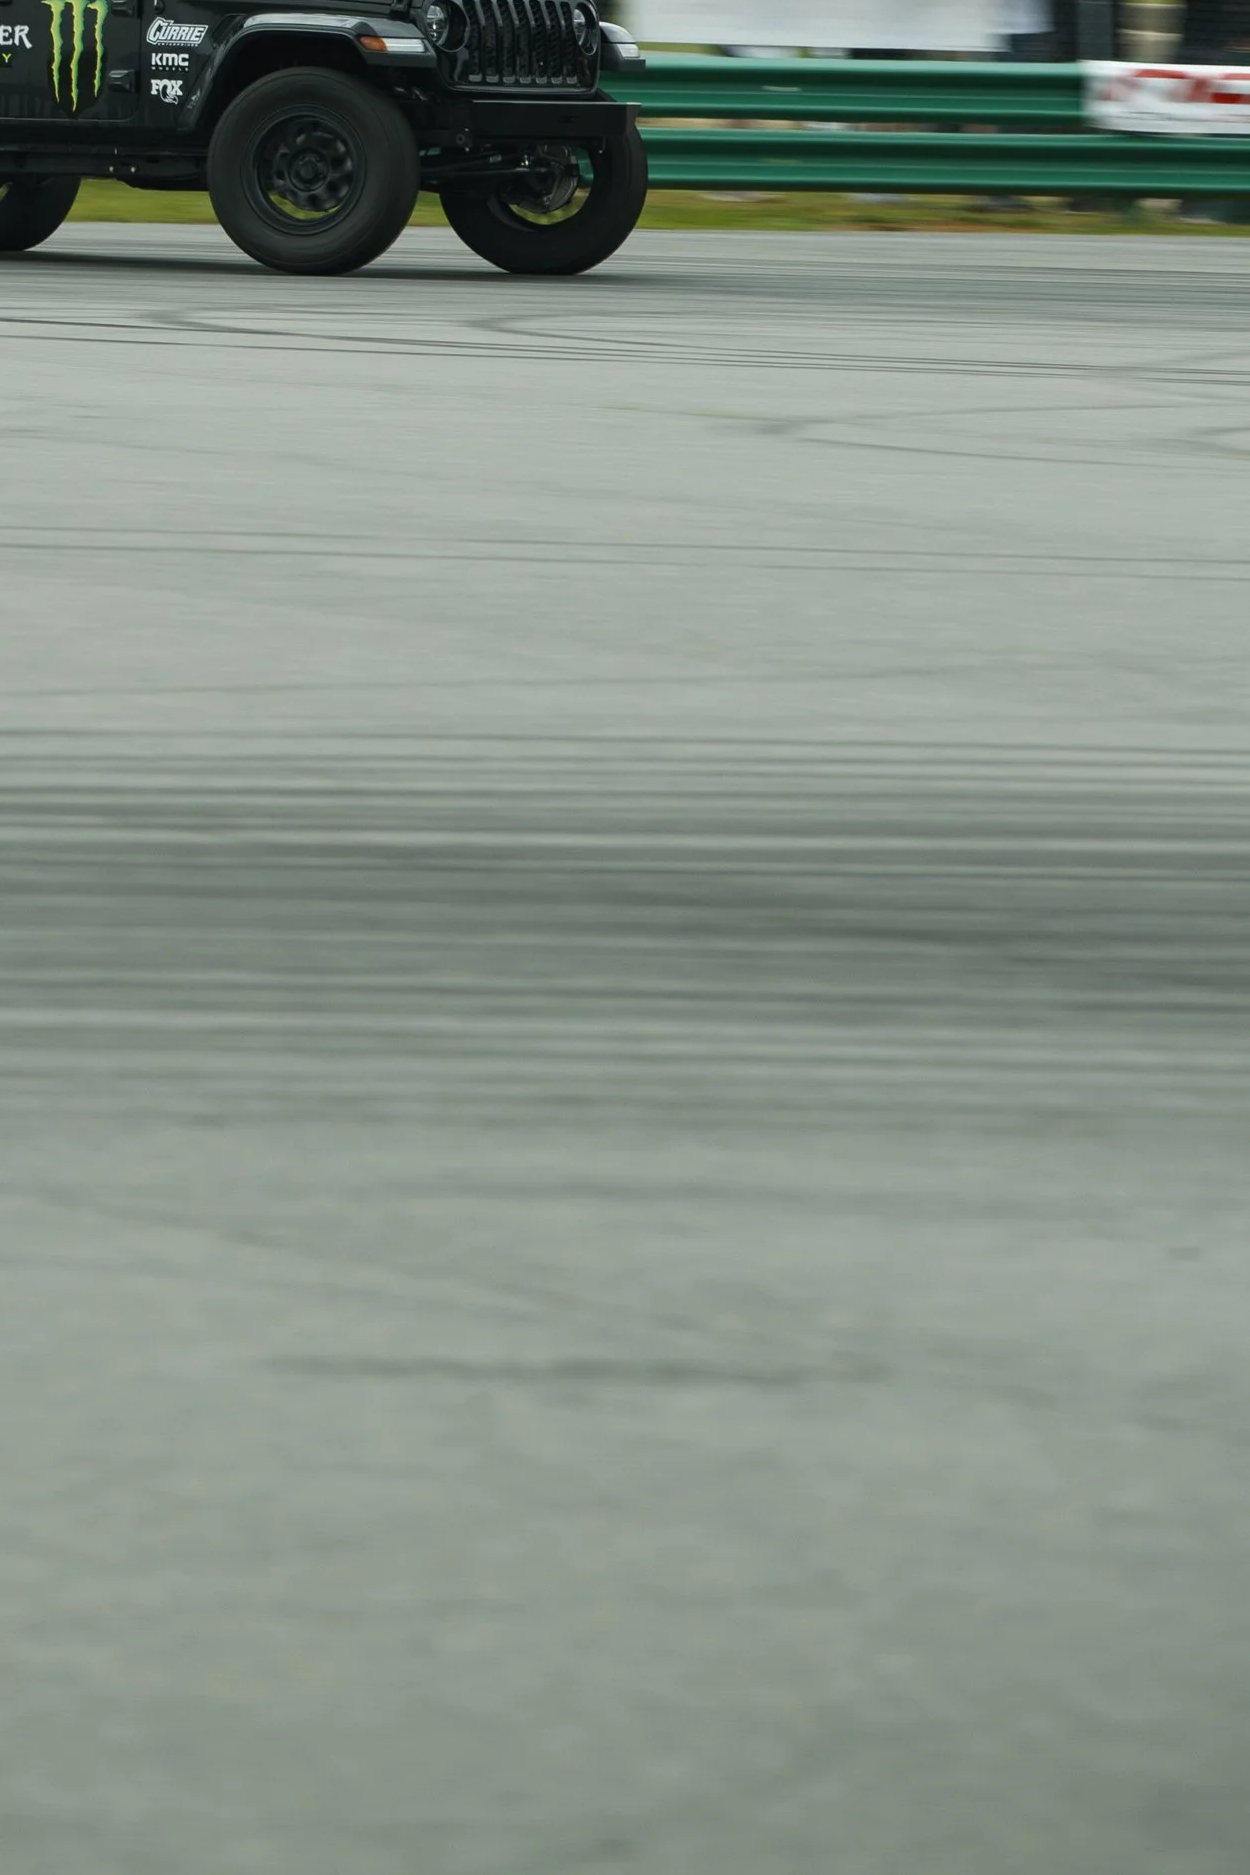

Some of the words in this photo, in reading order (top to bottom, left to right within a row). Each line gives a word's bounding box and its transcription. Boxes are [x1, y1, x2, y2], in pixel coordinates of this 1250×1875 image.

[148, 19, 206, 43] CURRIE
[151, 52, 190, 67] KMC
[150, 78, 183, 105] FOX
